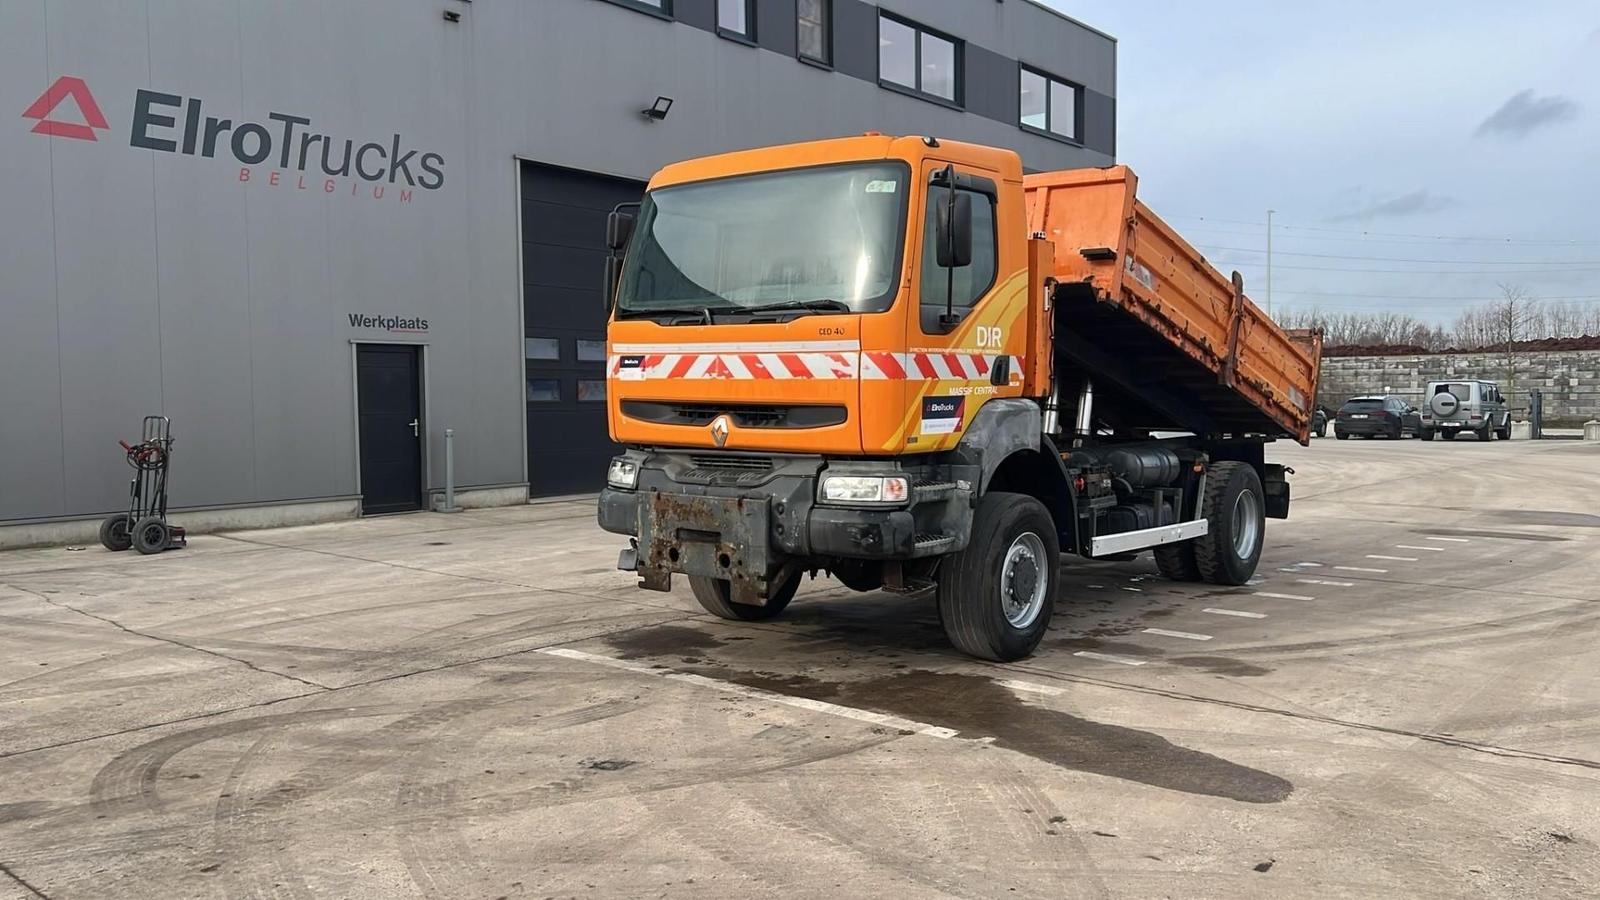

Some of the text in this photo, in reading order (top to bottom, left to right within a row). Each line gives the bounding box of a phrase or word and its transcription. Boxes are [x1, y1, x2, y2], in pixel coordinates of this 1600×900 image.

[130, 88, 445, 190] ElroTrucks
[239, 167, 413, 203] BELGIUM
[348, 313, 429, 331] Werkplaats
[976, 325, 1002, 348] DIR
[949, 386, 998, 395] MASSIF CENTRAL
